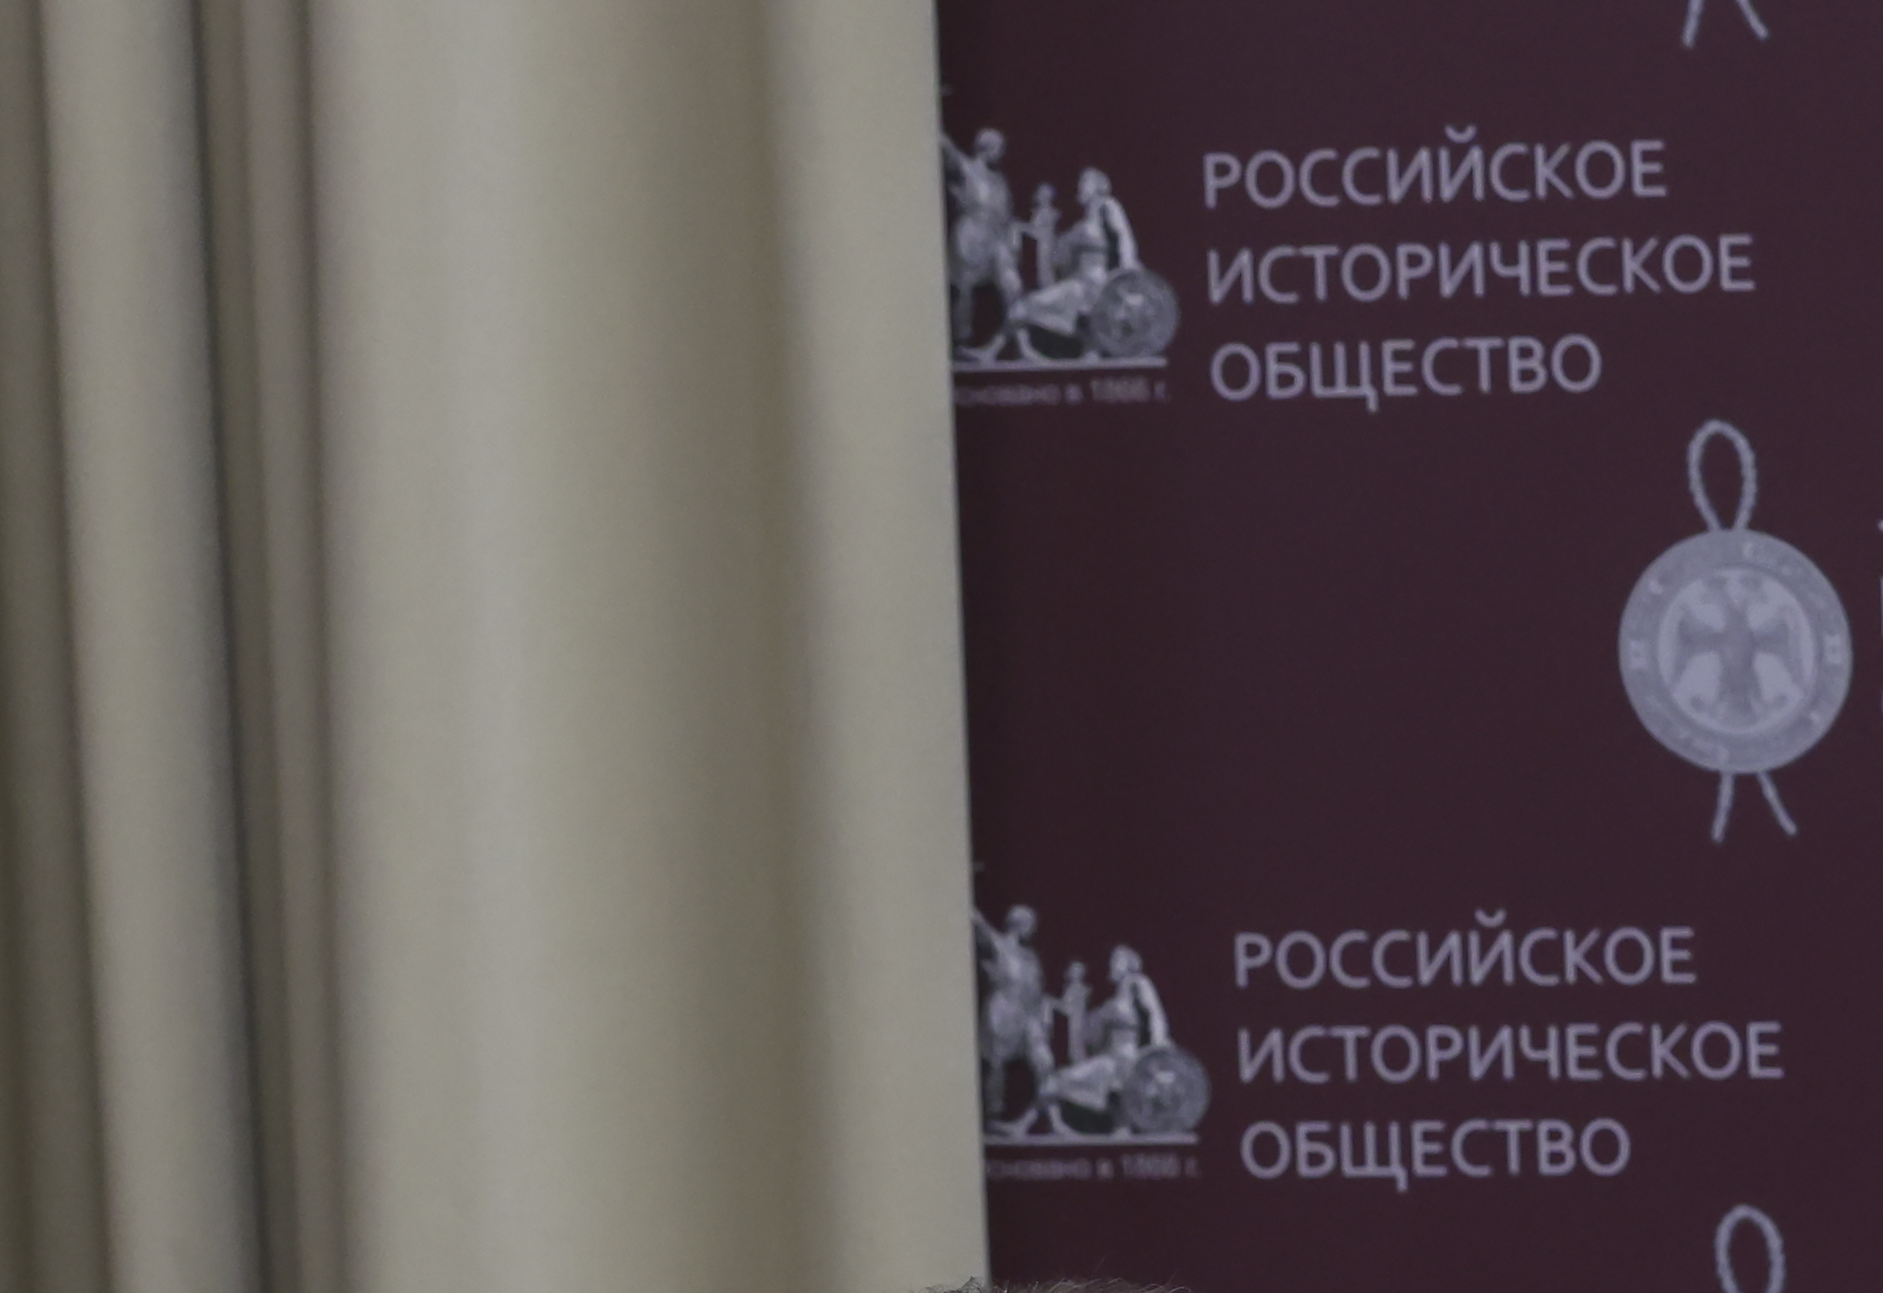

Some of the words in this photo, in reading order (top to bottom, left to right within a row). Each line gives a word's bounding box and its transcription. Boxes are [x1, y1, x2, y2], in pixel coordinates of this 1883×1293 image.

[1204, 125, 1669, 211] РОССИЙСКОЕ
[1208, 234, 1757, 306] ИСТОРИЧЕСКОЕ
[1210, 334, 1604, 415] ОБЩЕСТВО
[1234, 909, 1699, 991] РОССИЙСКОЕ
[1238, 1021, 1786, 1086] ИСТОРИЧЕСКОЕ
[1241, 1118, 1633, 1194] ОБЩЕСТВО
